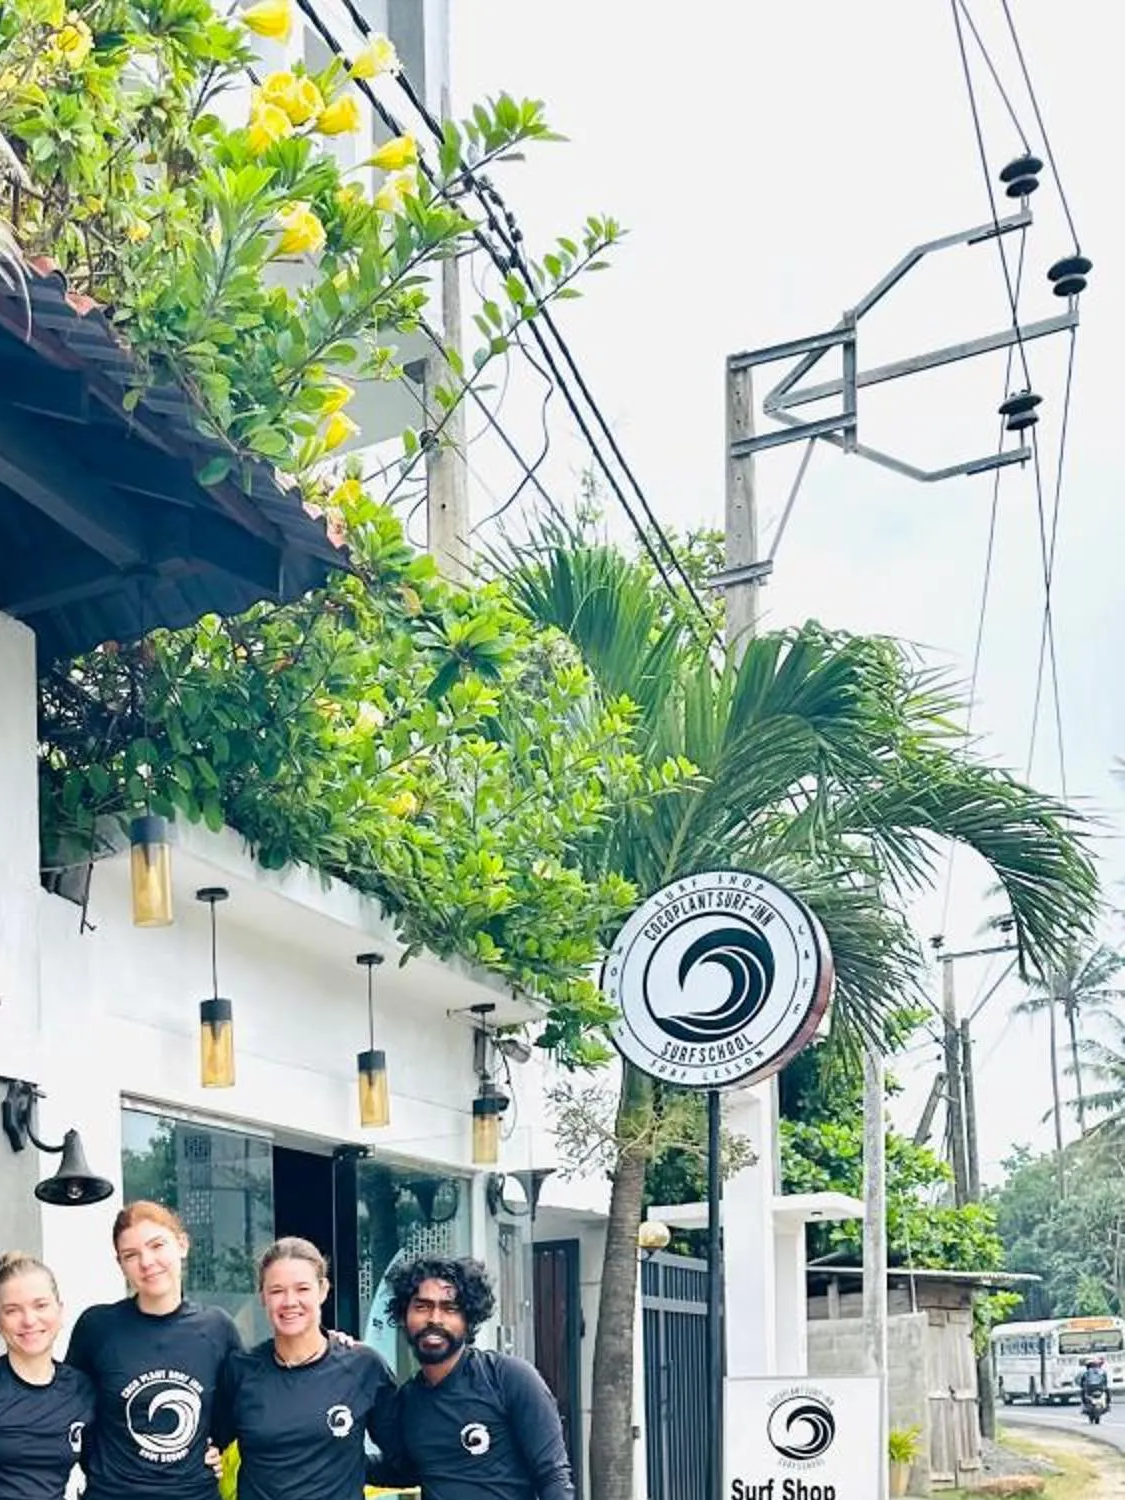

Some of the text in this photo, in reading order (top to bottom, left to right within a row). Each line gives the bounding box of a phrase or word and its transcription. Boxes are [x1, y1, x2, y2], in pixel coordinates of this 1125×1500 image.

[653, 875, 765, 907] SURF SHOP
[792, 924, 810, 1015] CAFE
[649, 1048, 766, 1081] SURF LESSON
